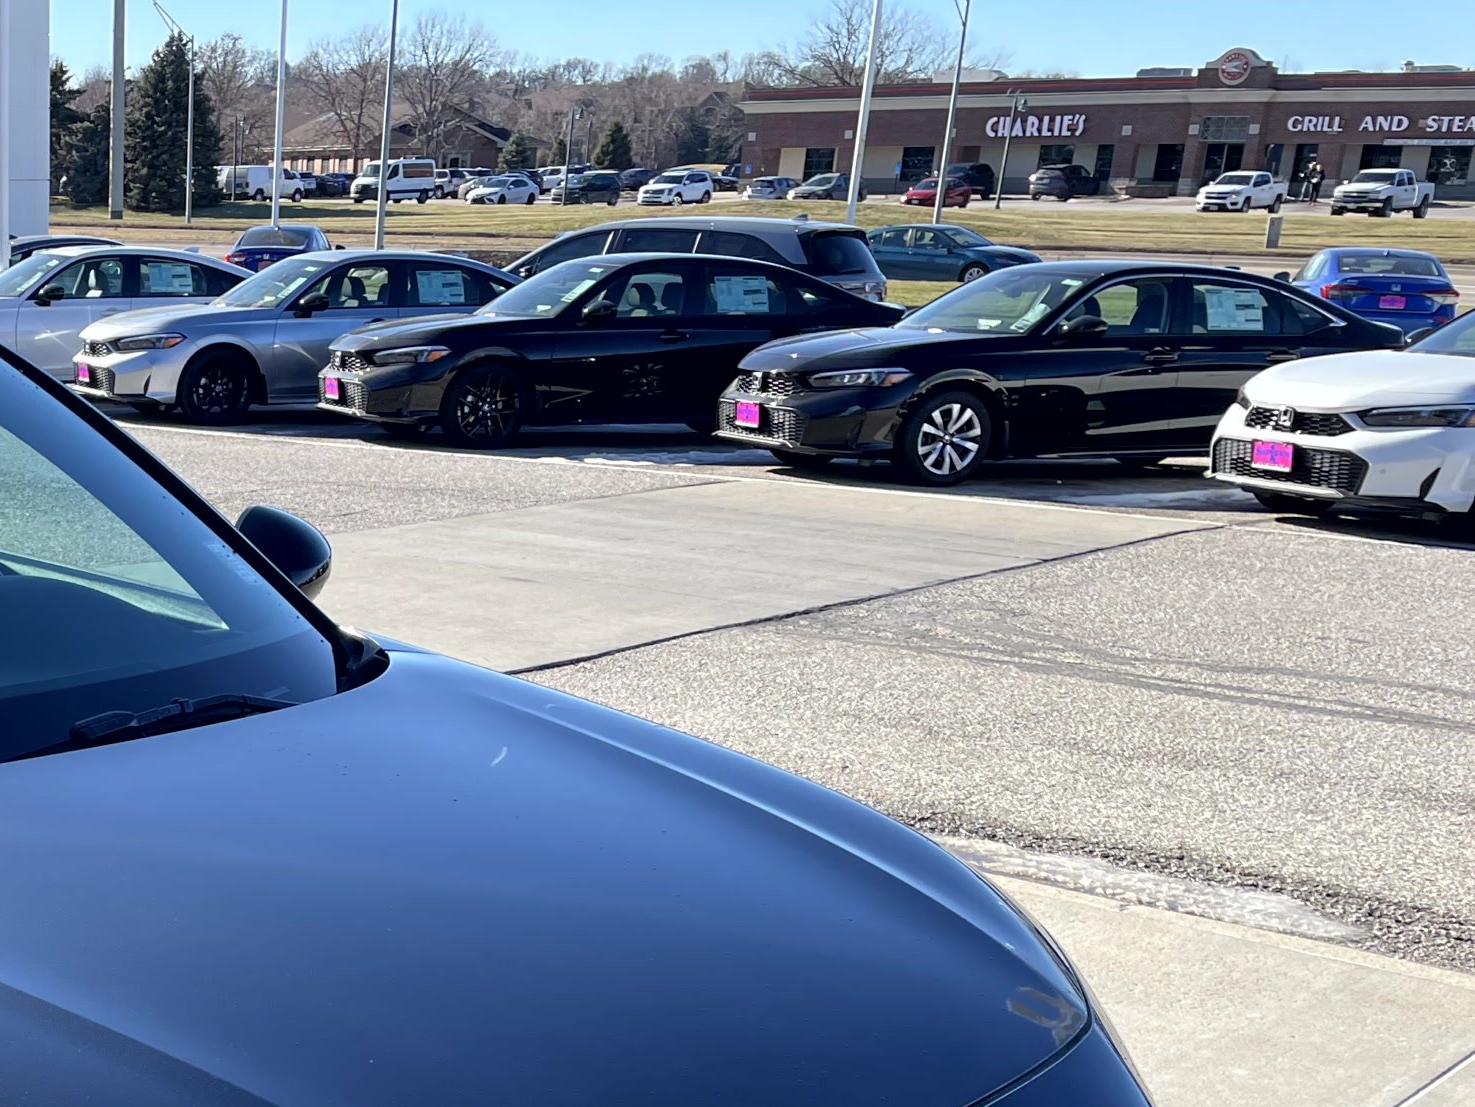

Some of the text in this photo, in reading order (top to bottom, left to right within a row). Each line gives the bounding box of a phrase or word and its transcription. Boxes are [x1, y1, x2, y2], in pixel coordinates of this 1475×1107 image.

[985, 114, 1086, 138] CHARLIE'S
[1287, 115, 1343, 132] GRILL
[1358, 115, 1409, 132] AND
